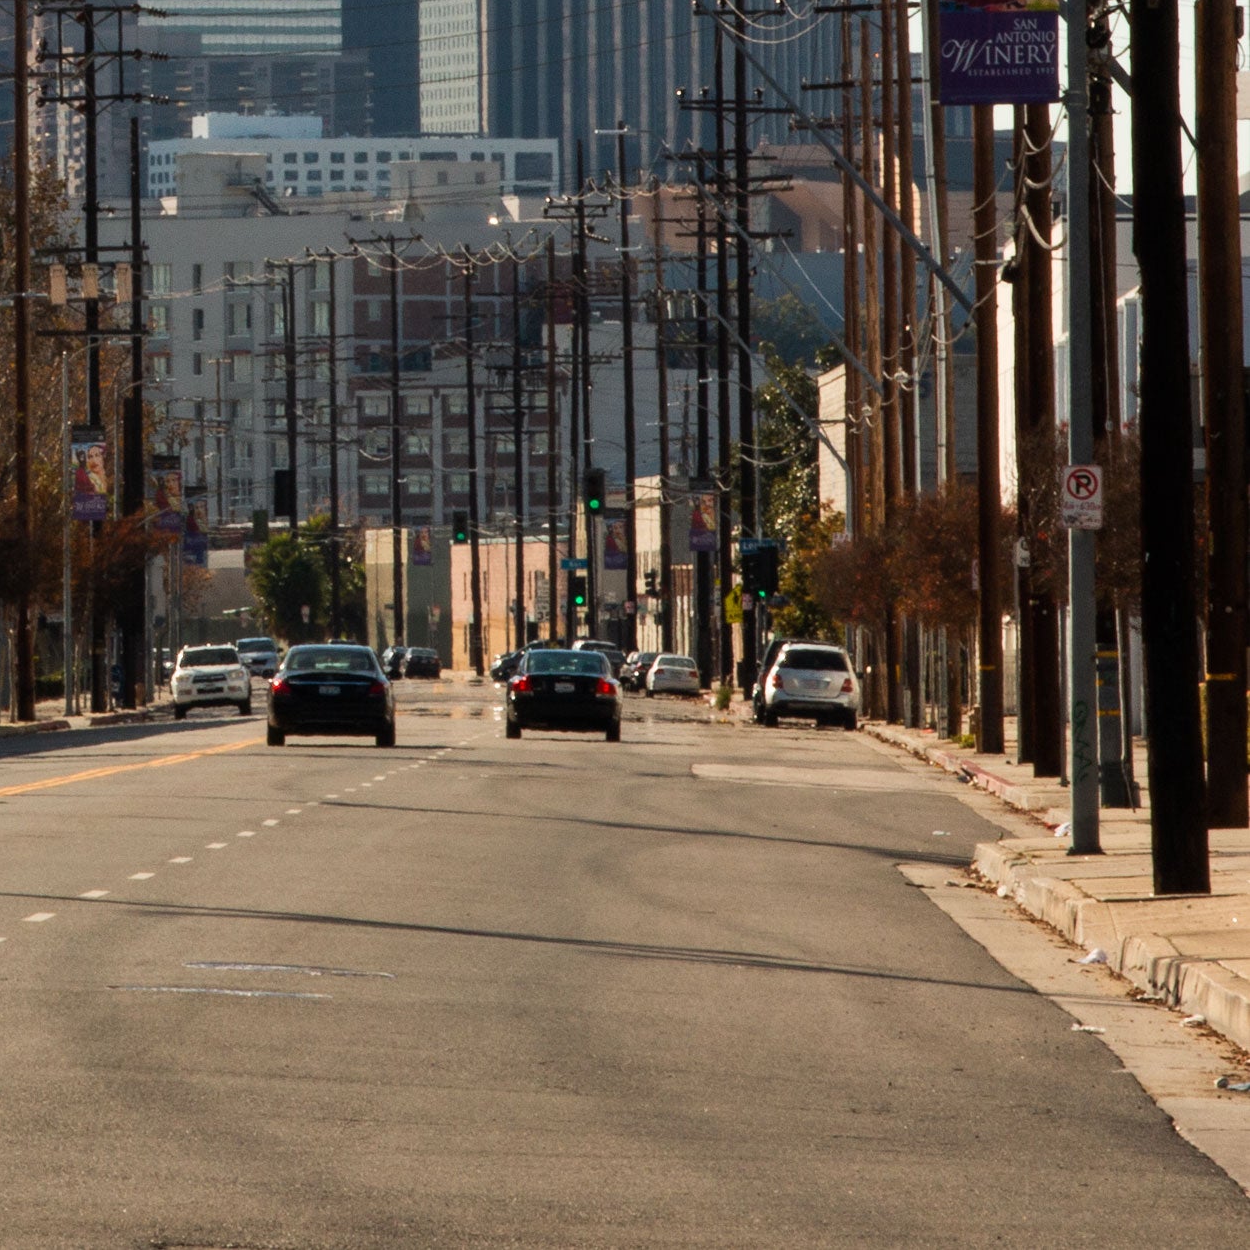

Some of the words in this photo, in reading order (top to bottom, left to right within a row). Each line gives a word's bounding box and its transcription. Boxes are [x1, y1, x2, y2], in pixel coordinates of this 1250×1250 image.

[1013, 18, 1038, 30] SAN
[995, 31, 1056, 43] ANTONIO
[941, 39, 1056, 72] WINERY
